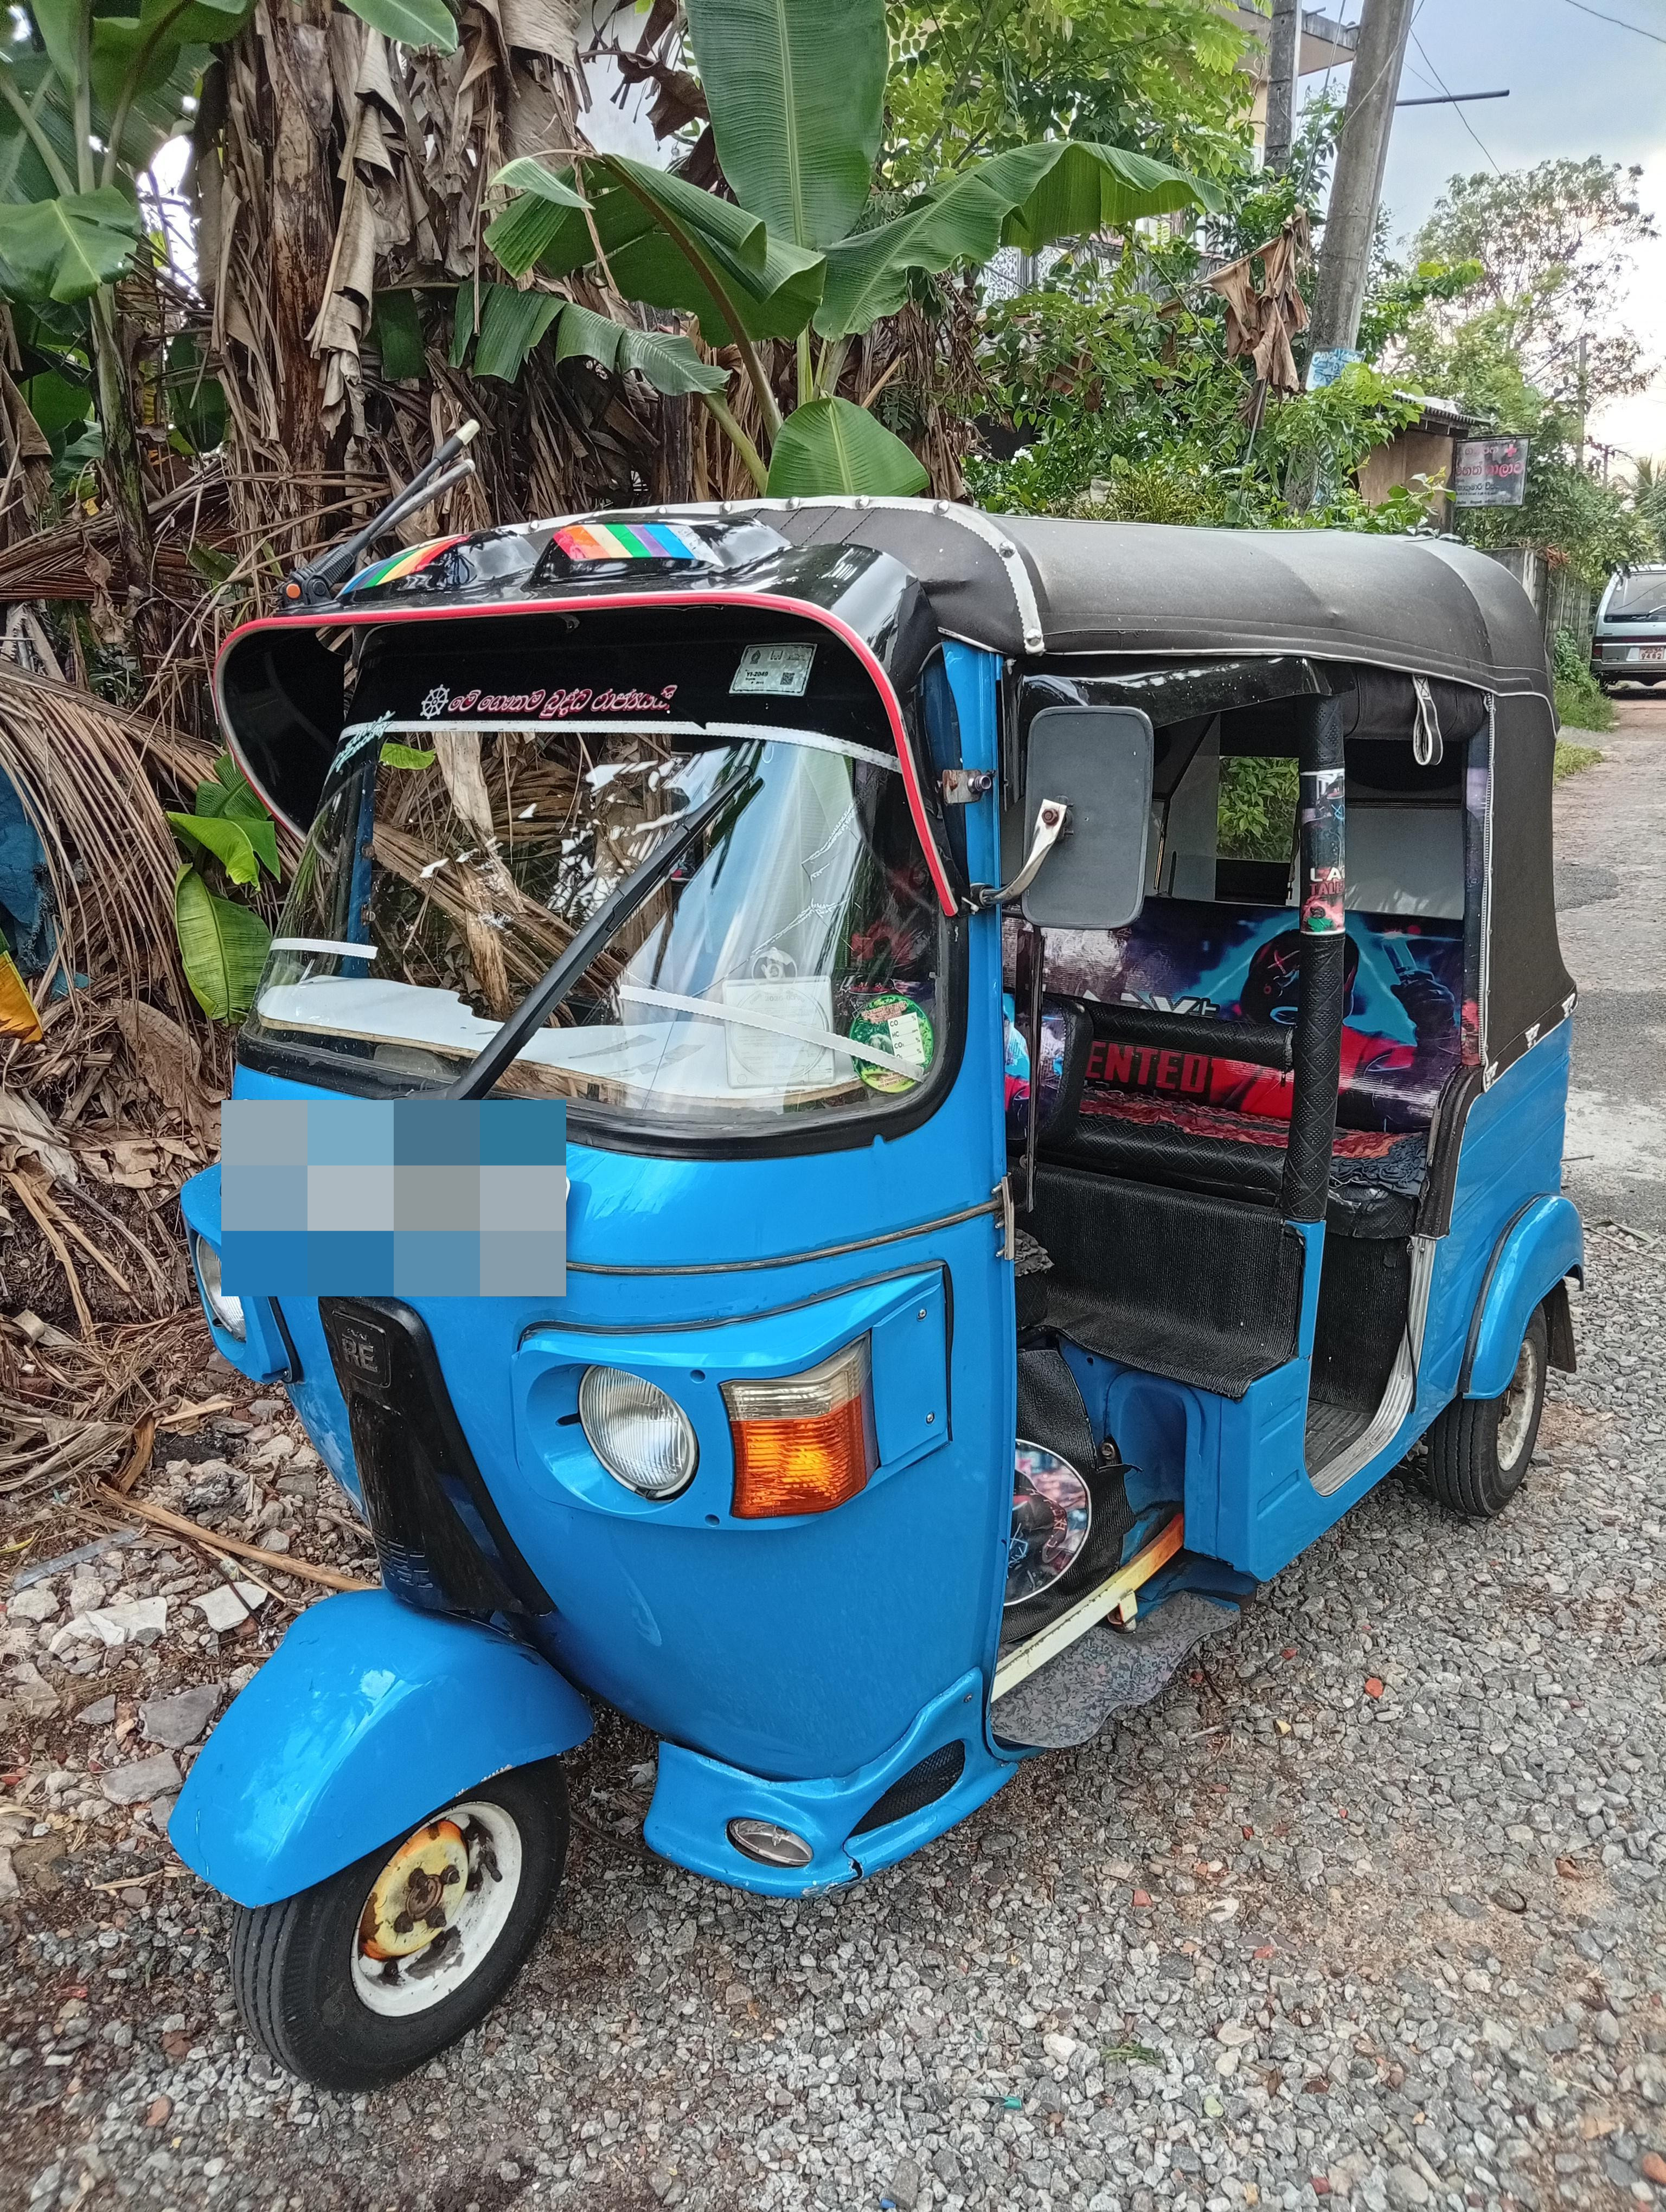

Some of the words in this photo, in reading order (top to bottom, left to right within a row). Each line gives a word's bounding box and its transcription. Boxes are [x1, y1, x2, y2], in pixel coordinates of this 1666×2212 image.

[1456, 461, 1482, 476] හෙත්
[447, 689, 482, 712] මේ
[1310, 866, 1345, 882] LA
[1310, 880, 1345, 895] TALE
[1085, 1040, 1210, 1093] ENTED
[341, 1333, 378, 1373] RE
